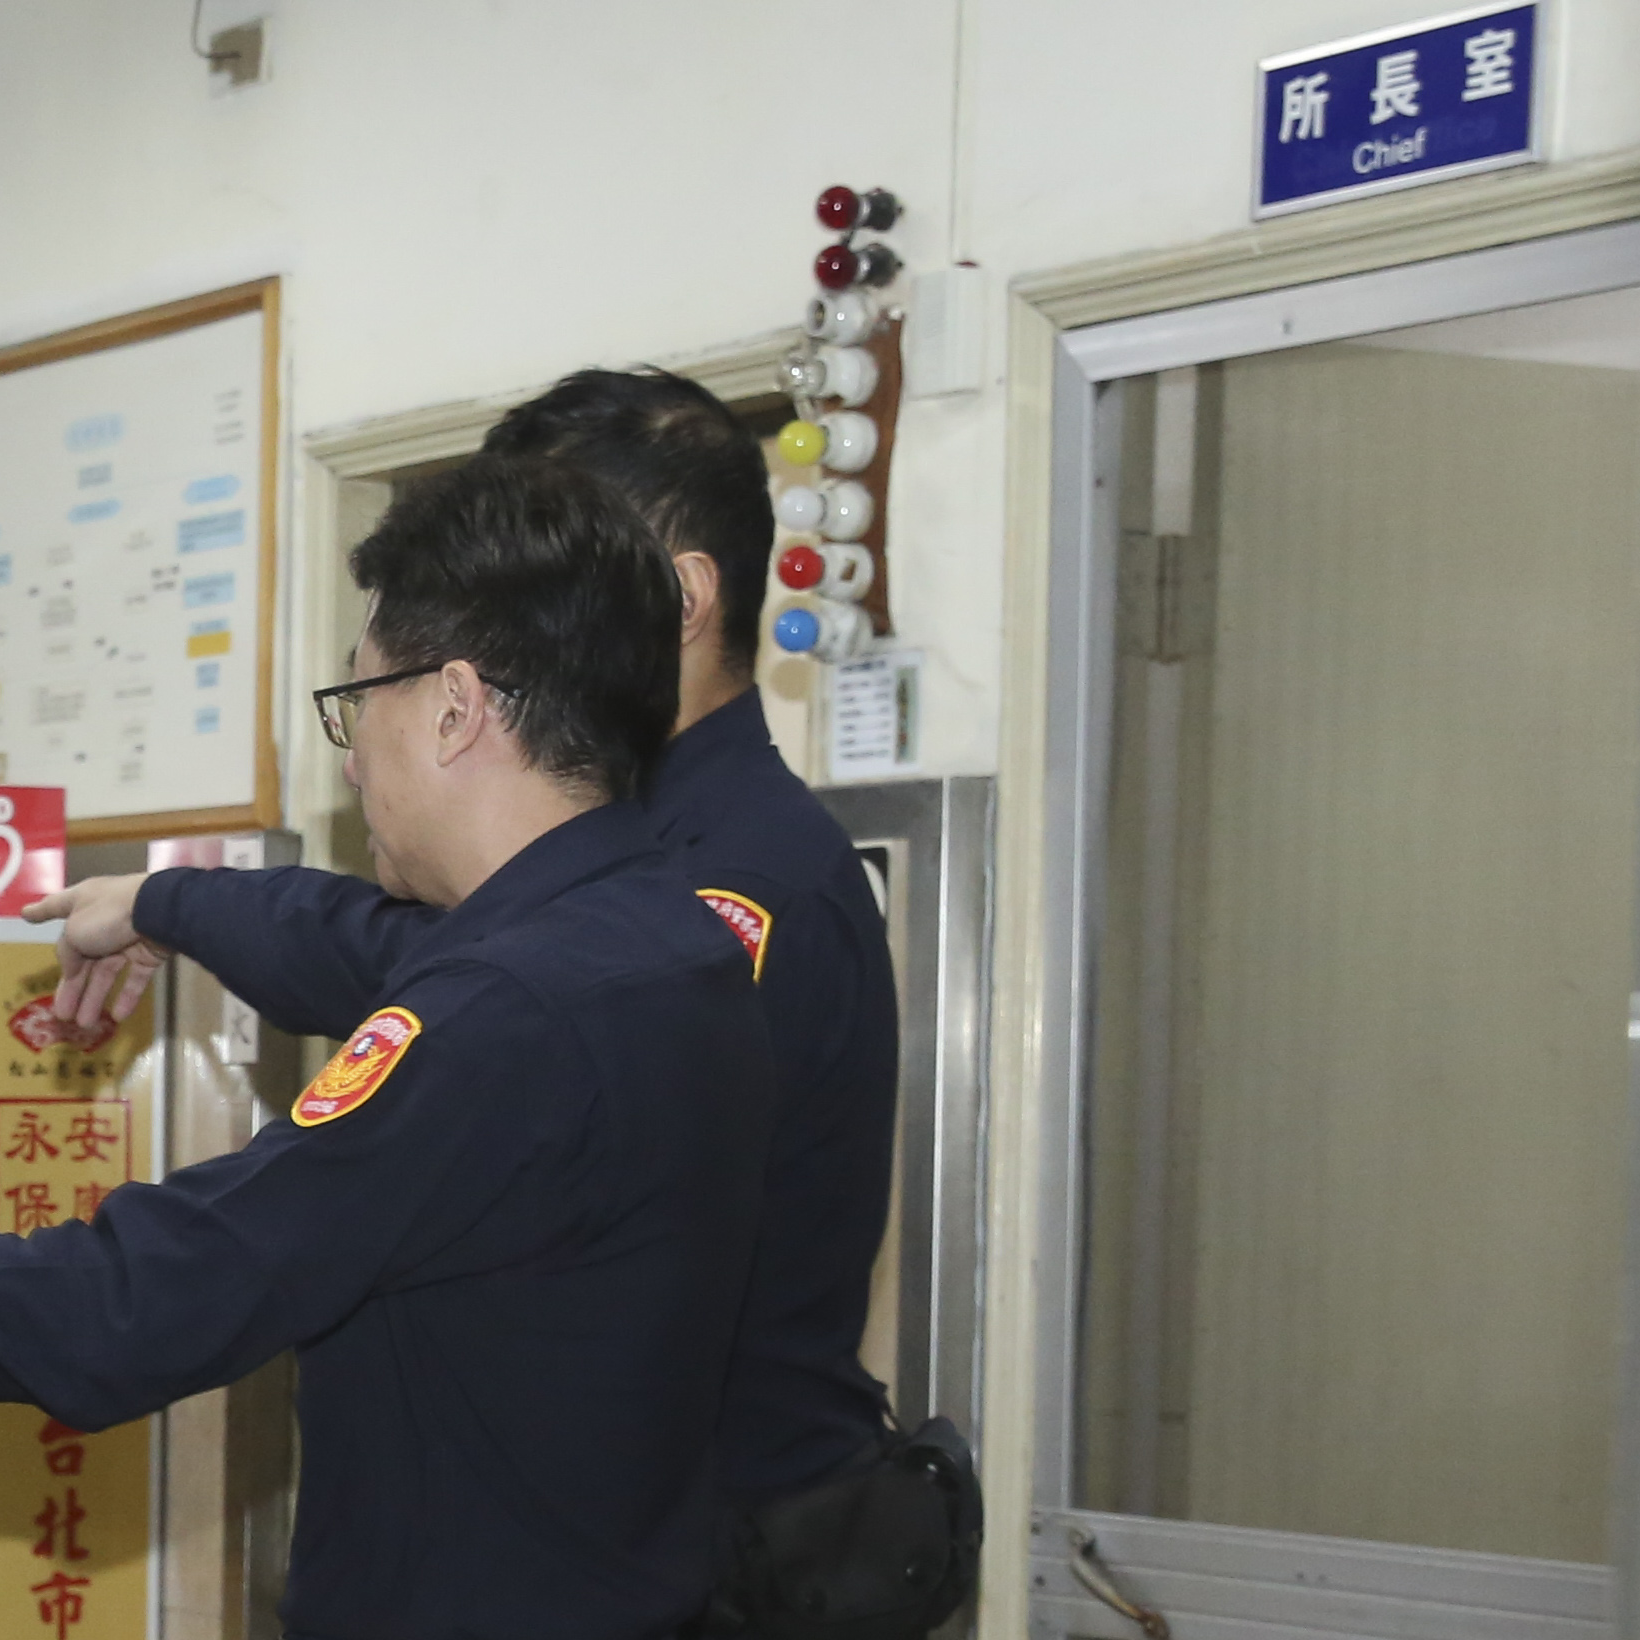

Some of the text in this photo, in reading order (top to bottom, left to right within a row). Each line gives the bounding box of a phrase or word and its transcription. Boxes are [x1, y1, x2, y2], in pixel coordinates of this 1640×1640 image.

[1279, 28, 1516, 143] 所長室
[1352, 127, 1427, 174] Chief
